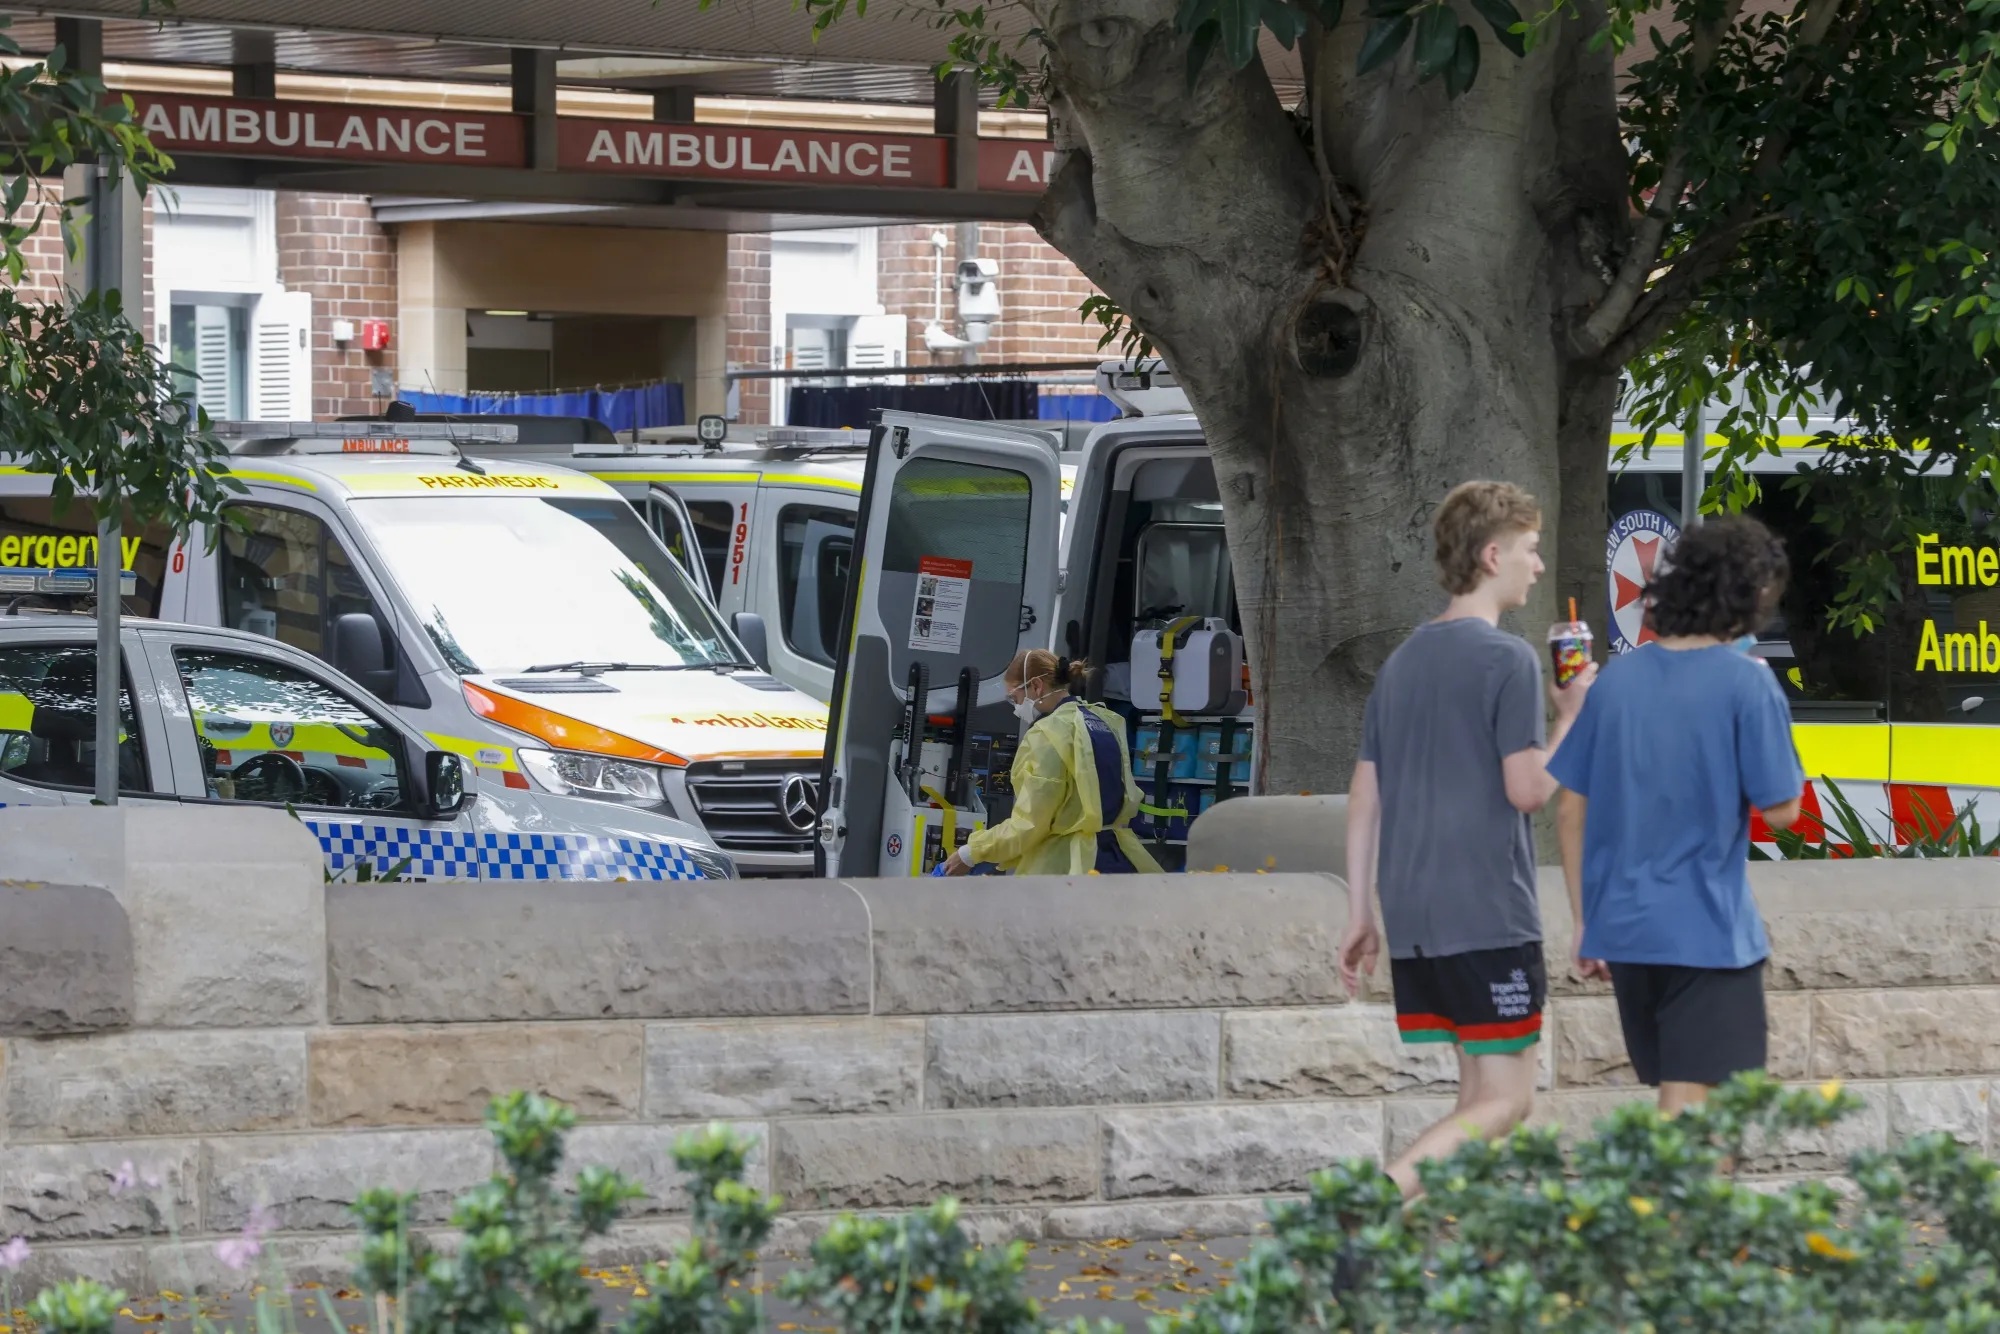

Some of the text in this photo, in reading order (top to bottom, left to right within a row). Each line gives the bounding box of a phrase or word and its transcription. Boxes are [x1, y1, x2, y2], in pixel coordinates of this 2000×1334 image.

[142, 103, 486, 157] AMBULANCE
[586, 129, 912, 178] AMBULANCE
[342, 439, 409, 453] AMBULANCE
[417, 475, 559, 489] PARAMEDIC
[1618, 512, 1660, 536] SOUTH
[0, 534, 142, 571] ergeny
[732, 502, 748, 585] 1951
[1916, 532, 2000, 587] Eme
[1916, 619, 2000, 674] Amb
[671, 712, 828, 731] mbulanc
[903, 709, 912, 744] FERNO
